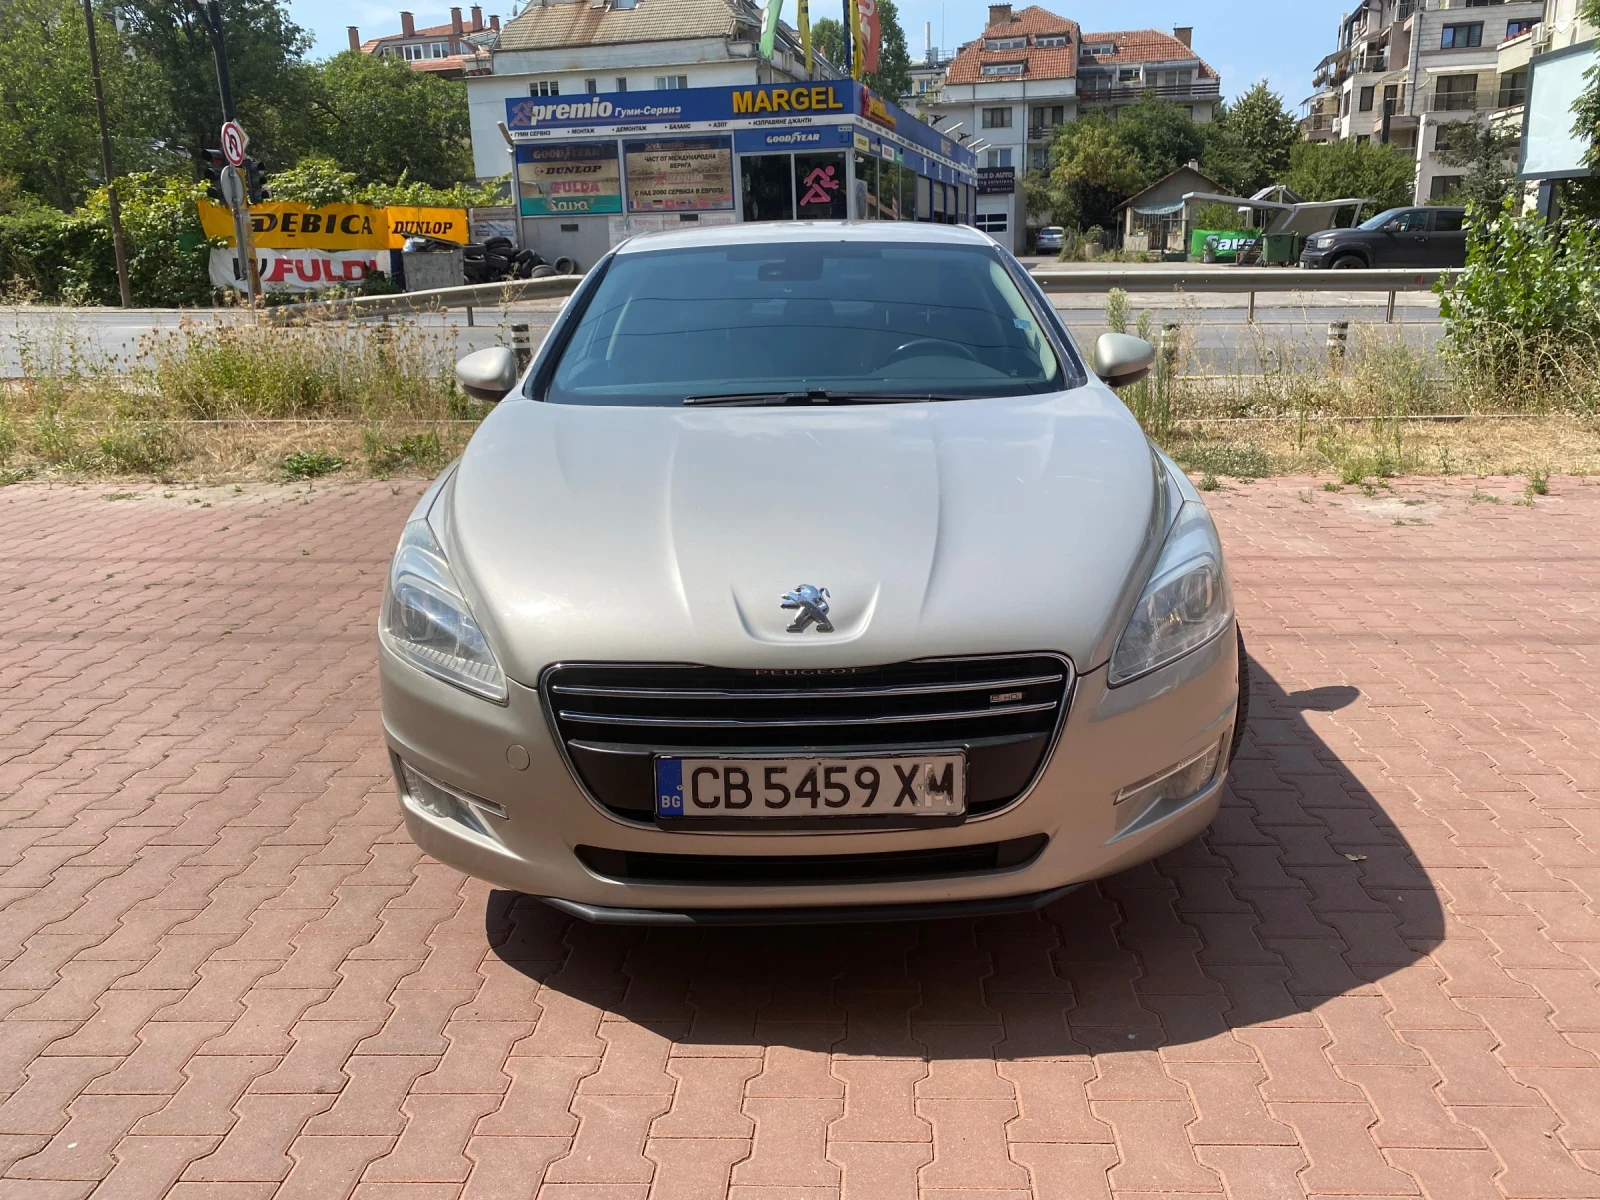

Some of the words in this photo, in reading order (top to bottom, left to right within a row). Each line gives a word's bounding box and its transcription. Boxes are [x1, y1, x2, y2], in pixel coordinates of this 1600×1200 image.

[732, 87, 843, 113] MARGEL
[531, 97, 612, 126] premio
[615, 106, 682, 119] Гуми-Сервиз
[753, 118, 786, 126] ИЗПРАВЯНЕ
[788, 117, 812, 125] ДЖАНТИ
[766, 132, 820, 144] GOODYEAR
[668, 153, 716, 161] МЕЖДУНАРОДНА
[546, 165, 601, 175] DUNLOP
[551, 182, 600, 194] FULDA
[550, 200, 590, 212] Sava
[392, 221, 453, 235] DUNLOP
[755, 668, 860, 676] PEUGEOT
[691, 766, 753, 809] CB
[764, 765, 881, 809] 5459
[661, 795, 681, 808] BG
